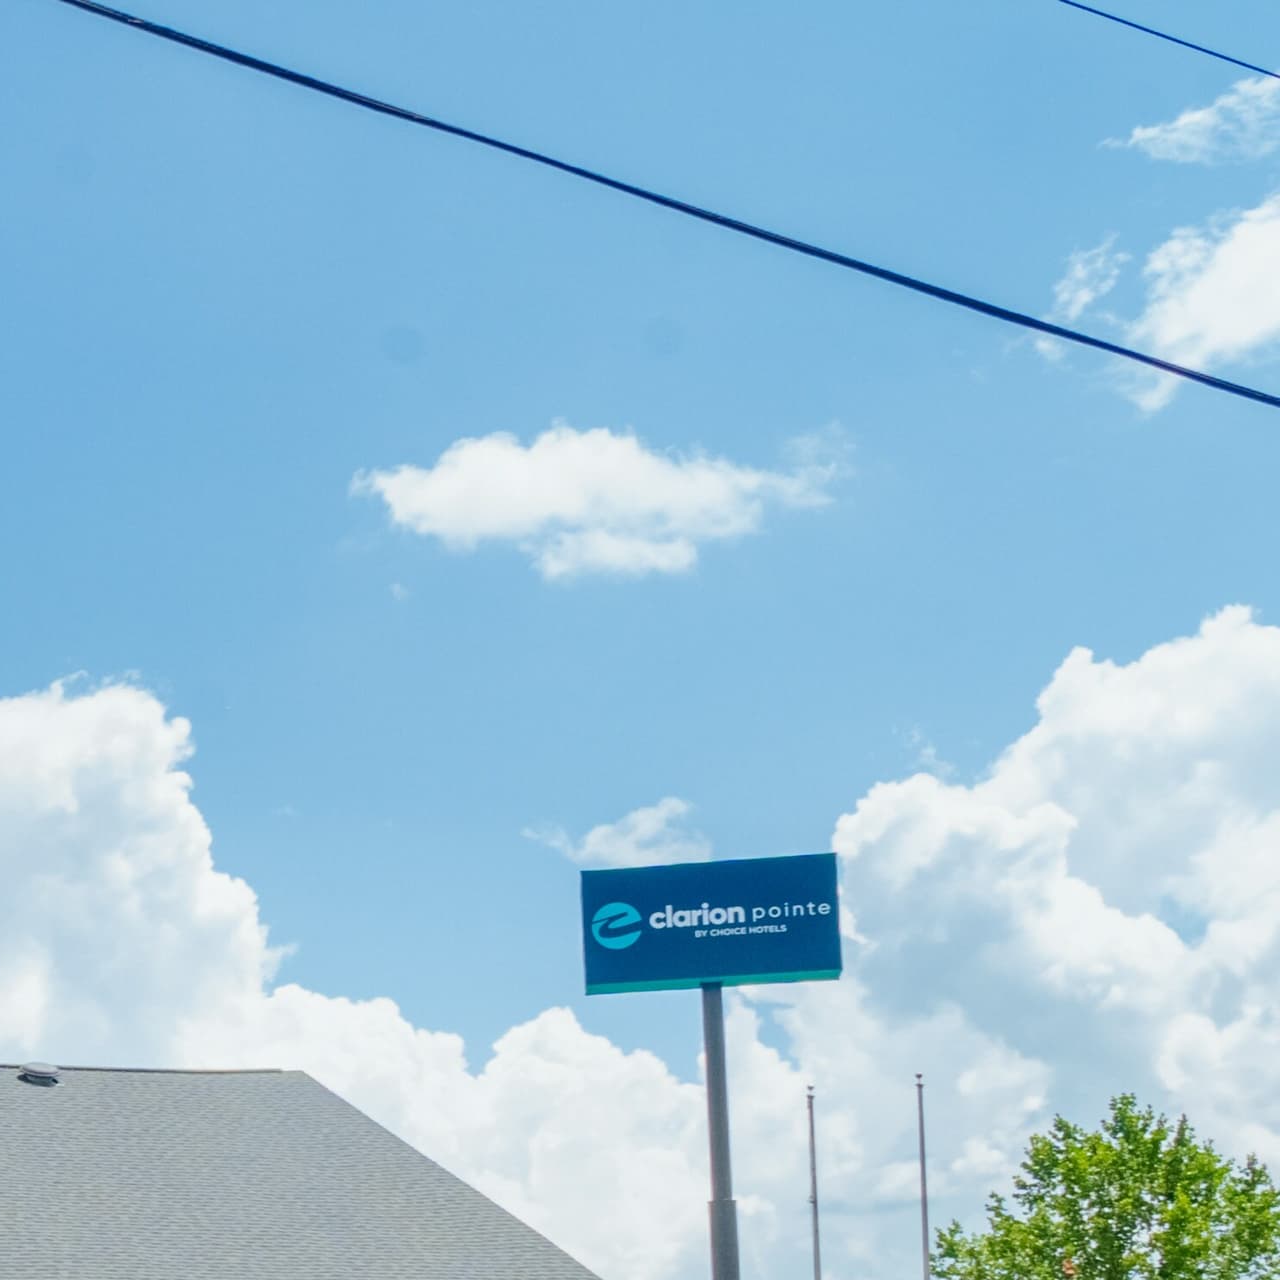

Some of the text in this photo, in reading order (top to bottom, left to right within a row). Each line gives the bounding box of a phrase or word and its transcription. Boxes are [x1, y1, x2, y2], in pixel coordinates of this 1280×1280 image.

[649, 901, 831, 929] clarion pointe
[694, 924, 787, 938] BY CHOICE HOTELS
